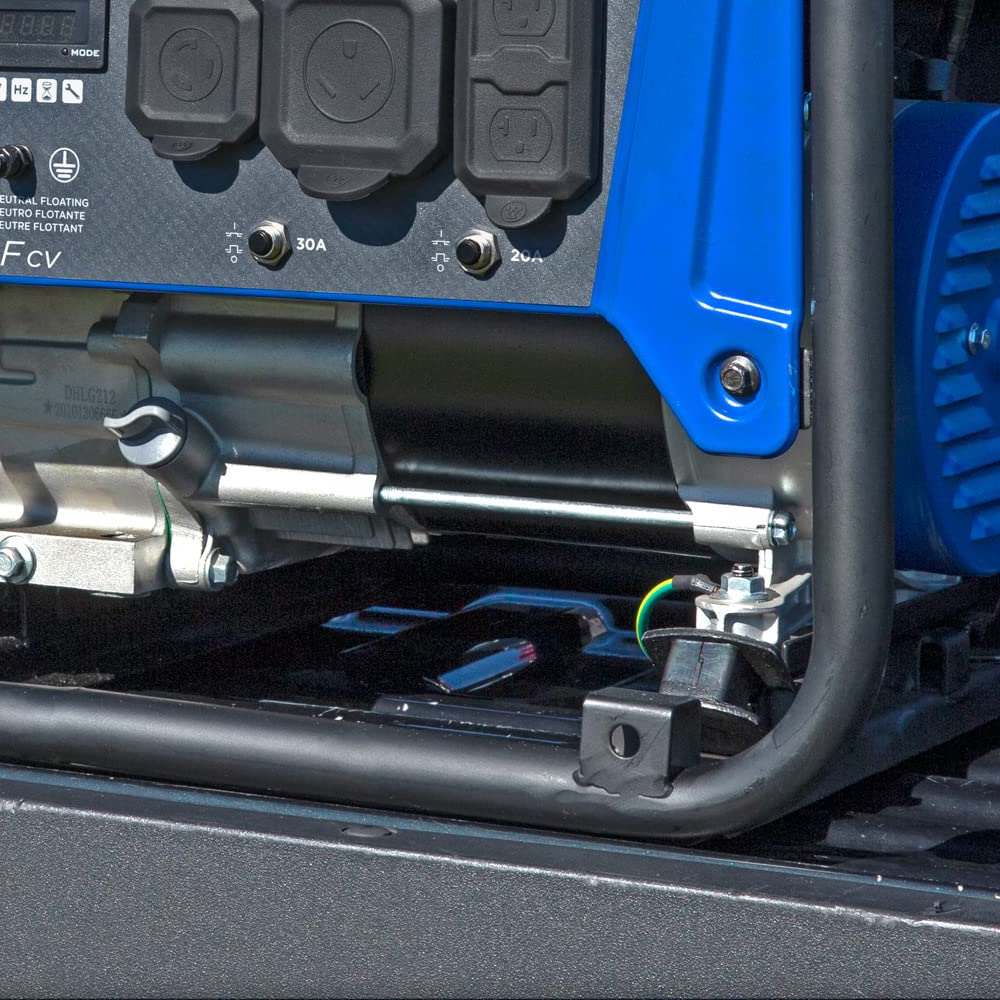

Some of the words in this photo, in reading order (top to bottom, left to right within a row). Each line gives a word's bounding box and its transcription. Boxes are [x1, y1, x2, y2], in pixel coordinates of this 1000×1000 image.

[70, 49, 100, 57] MODE
[14, 85, 29, 95] Hz
[40, 197, 89, 208] FLOATING
[35, 209, 86, 221] FLOTANTE
[33, 222, 84, 233] FLOTTANT
[296, 238, 327, 252] 30A
